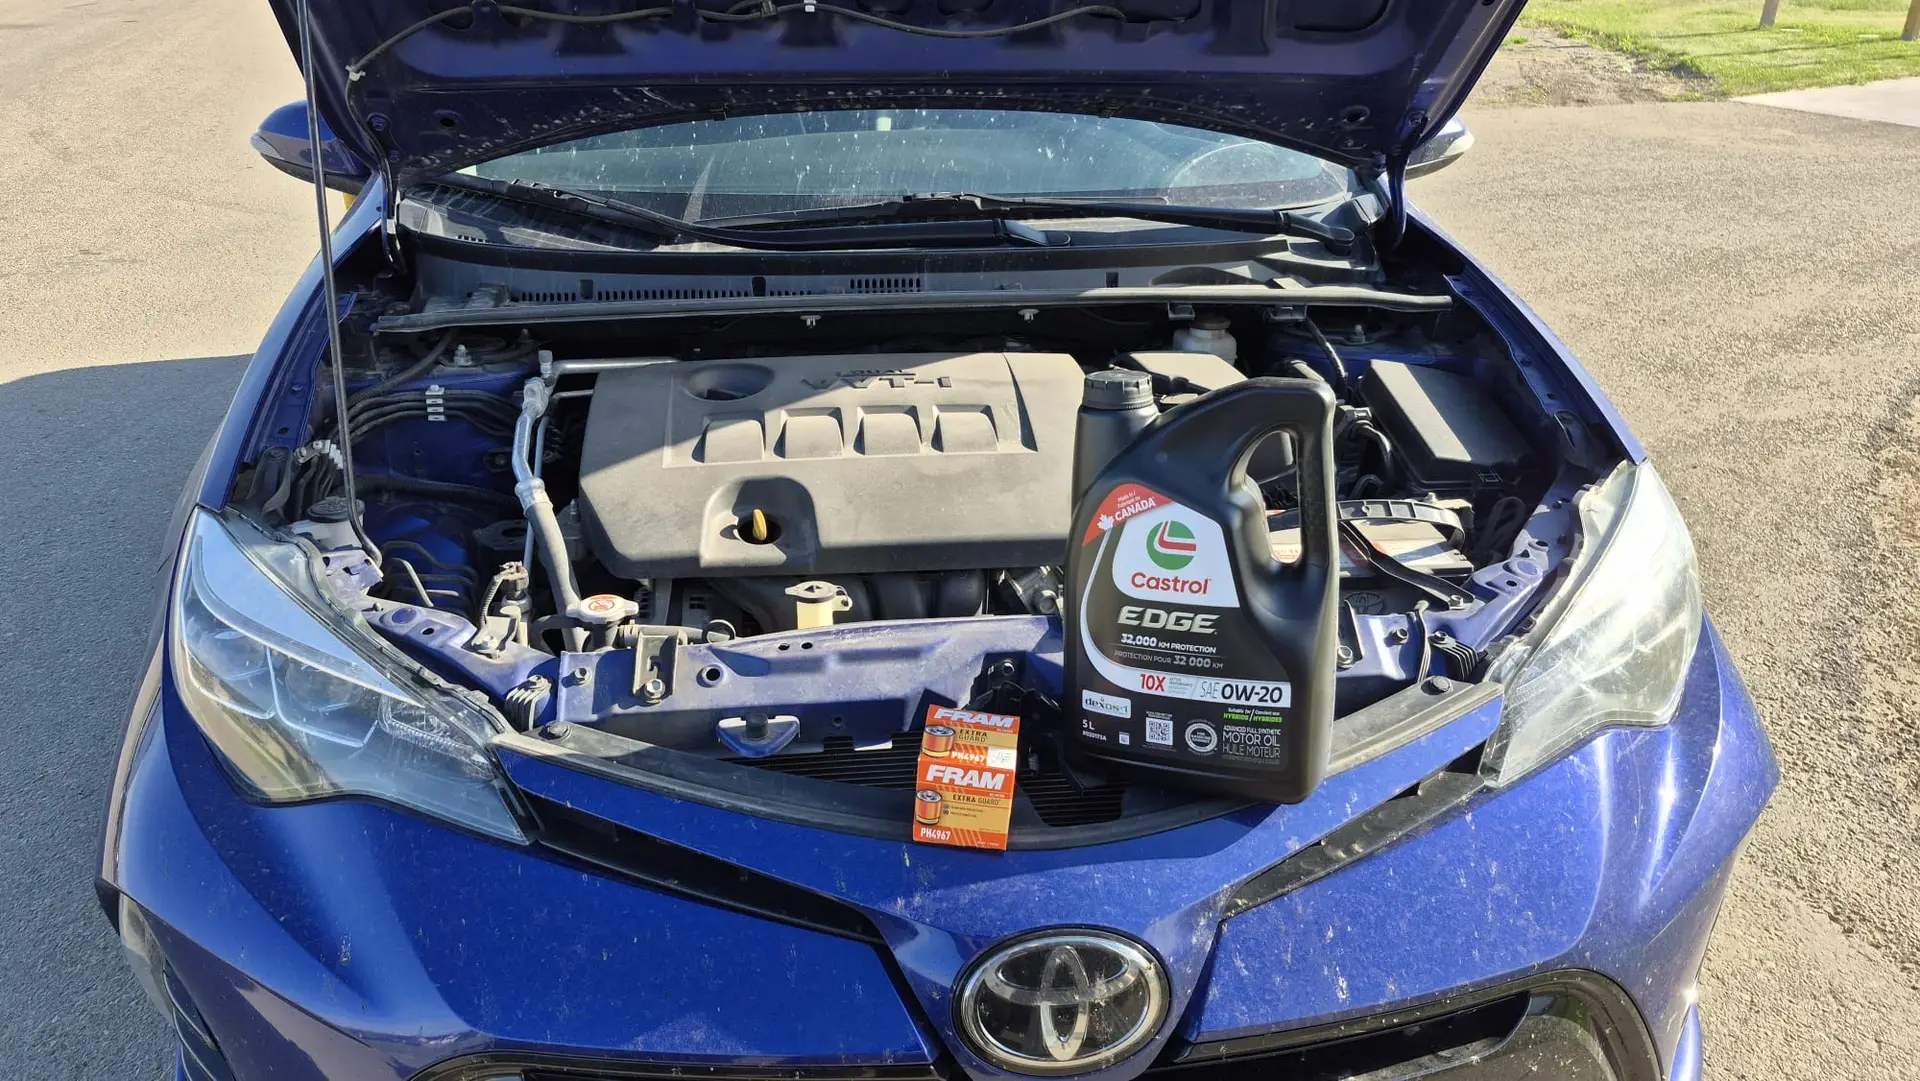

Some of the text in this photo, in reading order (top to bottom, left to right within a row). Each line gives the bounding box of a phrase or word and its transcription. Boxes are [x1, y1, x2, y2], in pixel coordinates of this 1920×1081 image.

[1115, 496, 1156, 521] CANADA
[1131, 572, 1208, 595] Castrol
[1117, 605, 1220, 634] EDGE
[1120, 633, 1216, 654] 32,000 KM PROTECTION
[1114, 650, 1153, 661] PROTECTION
[1153, 655, 1172, 664] POUR
[1173, 655, 1187, 666] 32
[1188, 658, 1211, 668] 000
[1140, 673, 1166, 692] 10X
[1200, 681, 1220, 699] SAE
[1221, 683, 1283, 704] 0W-20
[934, 708, 1015, 728] FRAM
[1082, 719, 1095, 730] 5 L
[959, 735, 987, 743] GUARD
[960, 728, 987, 737] EXTRA
[1222, 731, 1262, 746] MOTOR
[1263, 734, 1281, 747] OIL
[951, 751, 985, 762] PH4967
[1222, 743, 1245, 756] HUILE
[1246, 745, 1281, 759] MOTEUR
[926, 764, 1005, 790] FRAM
[952, 794, 1000, 806] EXTRA GUARD
[920, 827, 951, 841] PH4967
